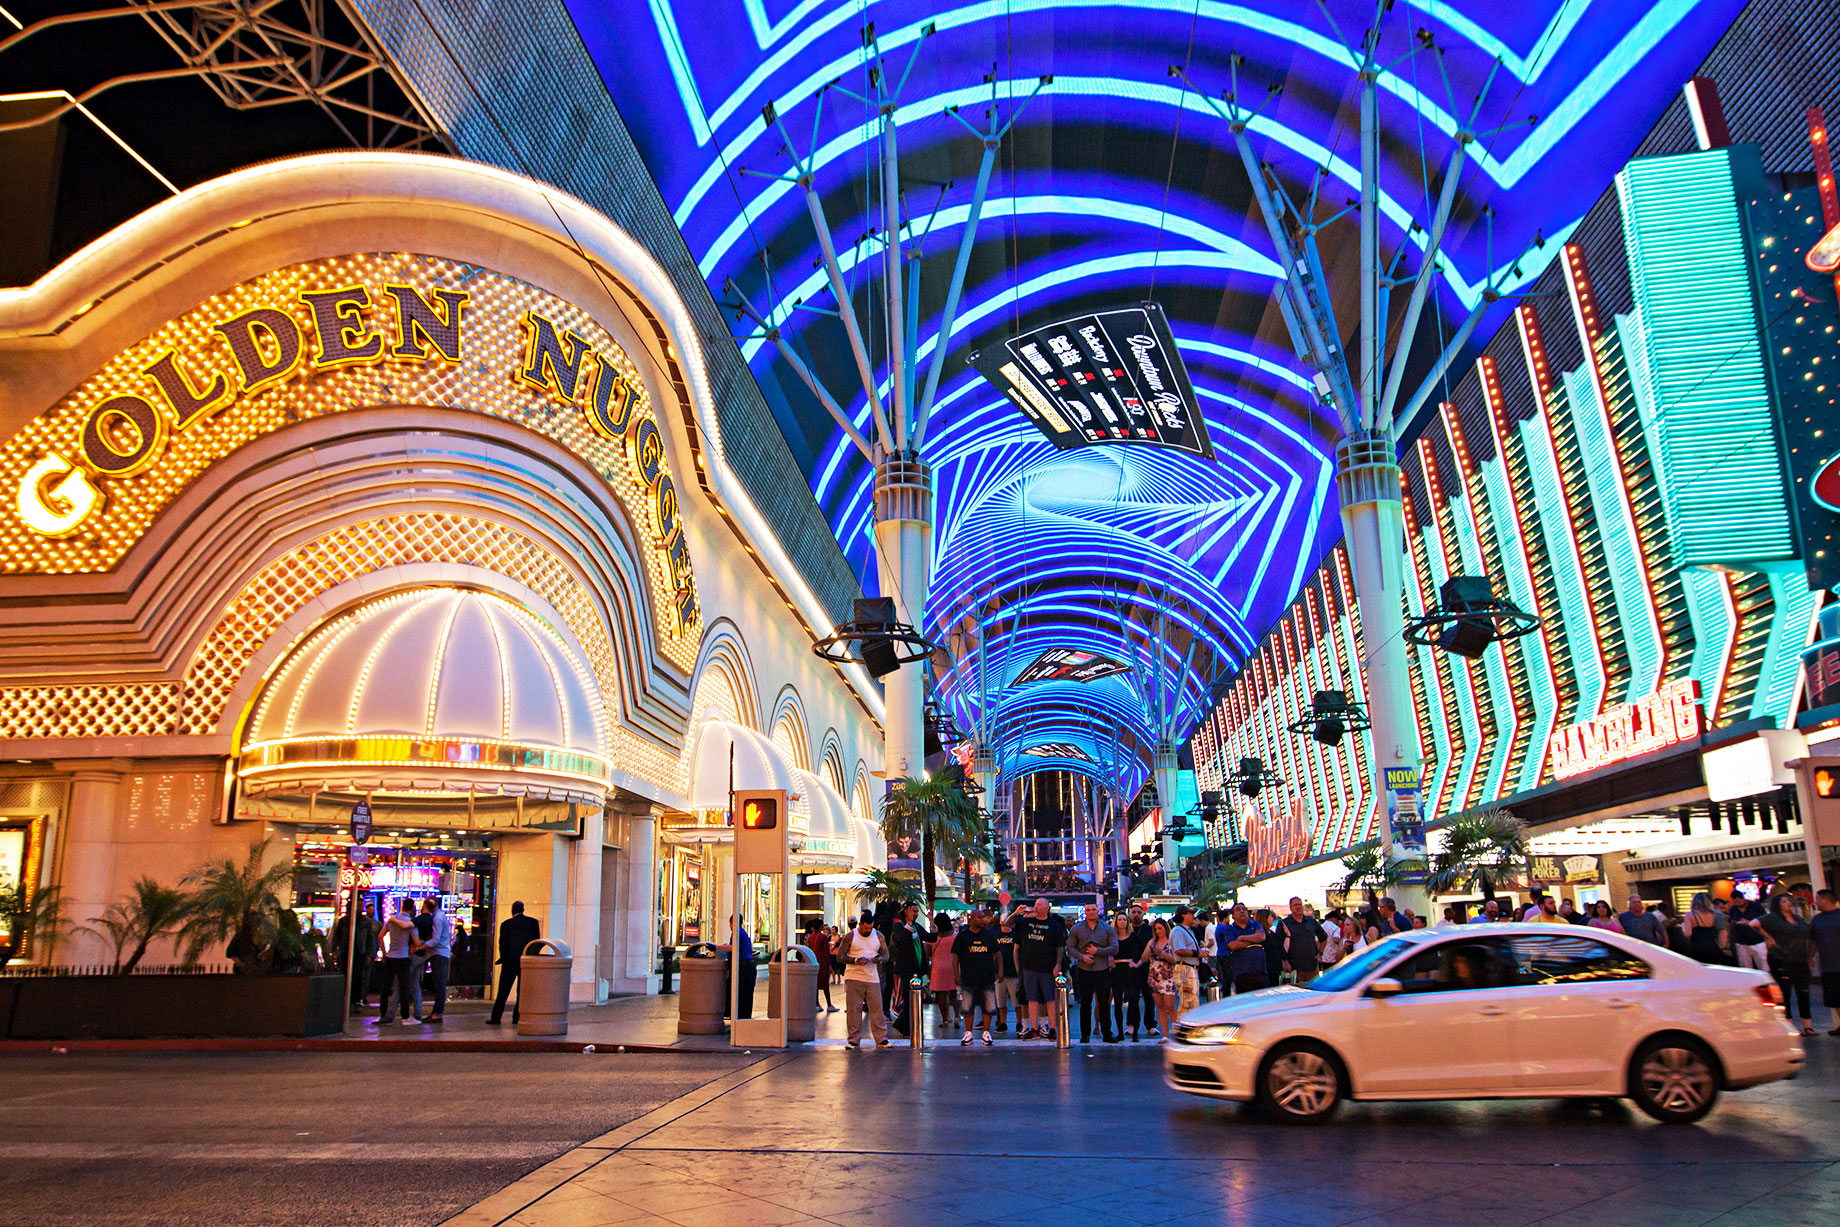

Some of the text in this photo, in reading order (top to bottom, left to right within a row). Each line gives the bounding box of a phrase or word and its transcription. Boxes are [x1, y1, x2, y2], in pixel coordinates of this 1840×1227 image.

[1126, 334, 1164, 391] Downtown
[15, 282, 702, 640] GOLDEN NUGGET
[1550, 675, 1700, 781] GAMBLING
[1388, 770, 1418, 783] NOW
[1532, 867, 1560, 878] POKER
[1535, 858, 1554, 868] LIVE
